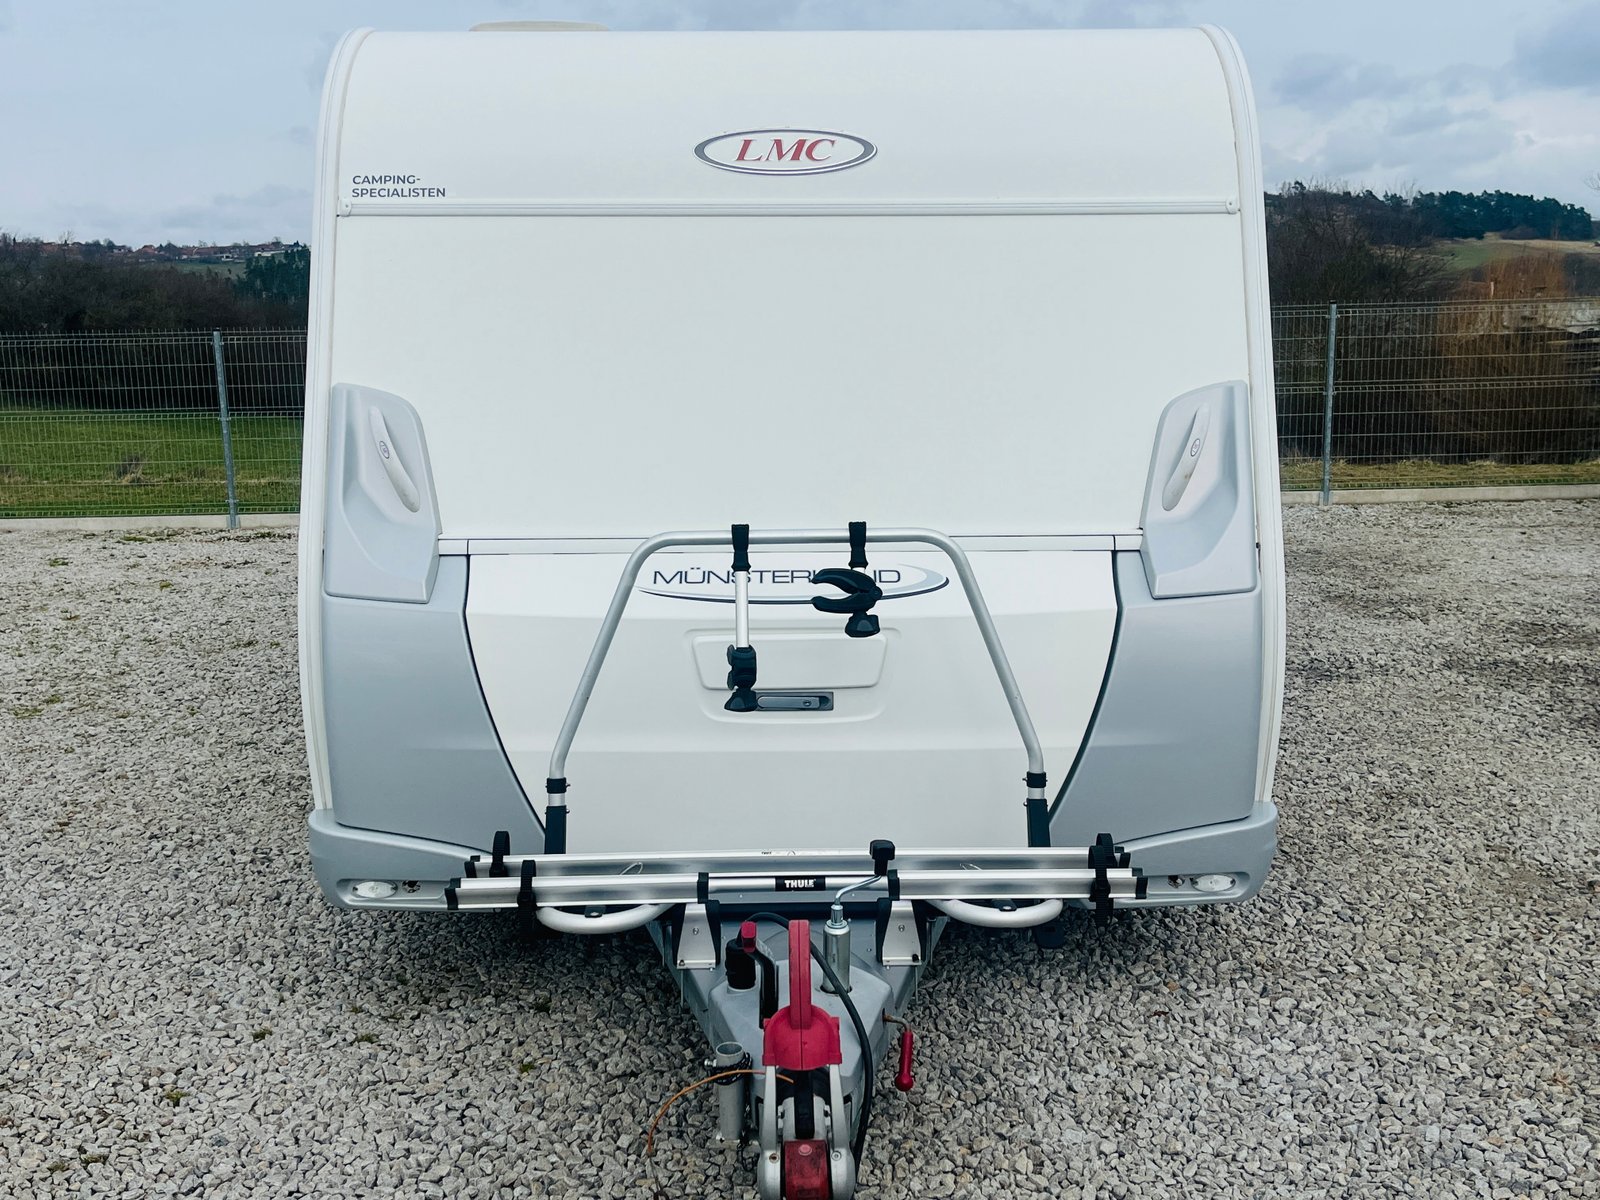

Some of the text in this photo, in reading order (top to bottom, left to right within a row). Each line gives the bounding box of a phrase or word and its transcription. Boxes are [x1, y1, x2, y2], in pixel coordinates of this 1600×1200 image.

[735, 138, 837, 162] LMC
[352, 174, 421, 185] CAMPING-
[351, 187, 446, 198] SPECIALISTEN
[653, 567, 901, 584] MÜNTERD
[784, 879, 815, 888] THULE
